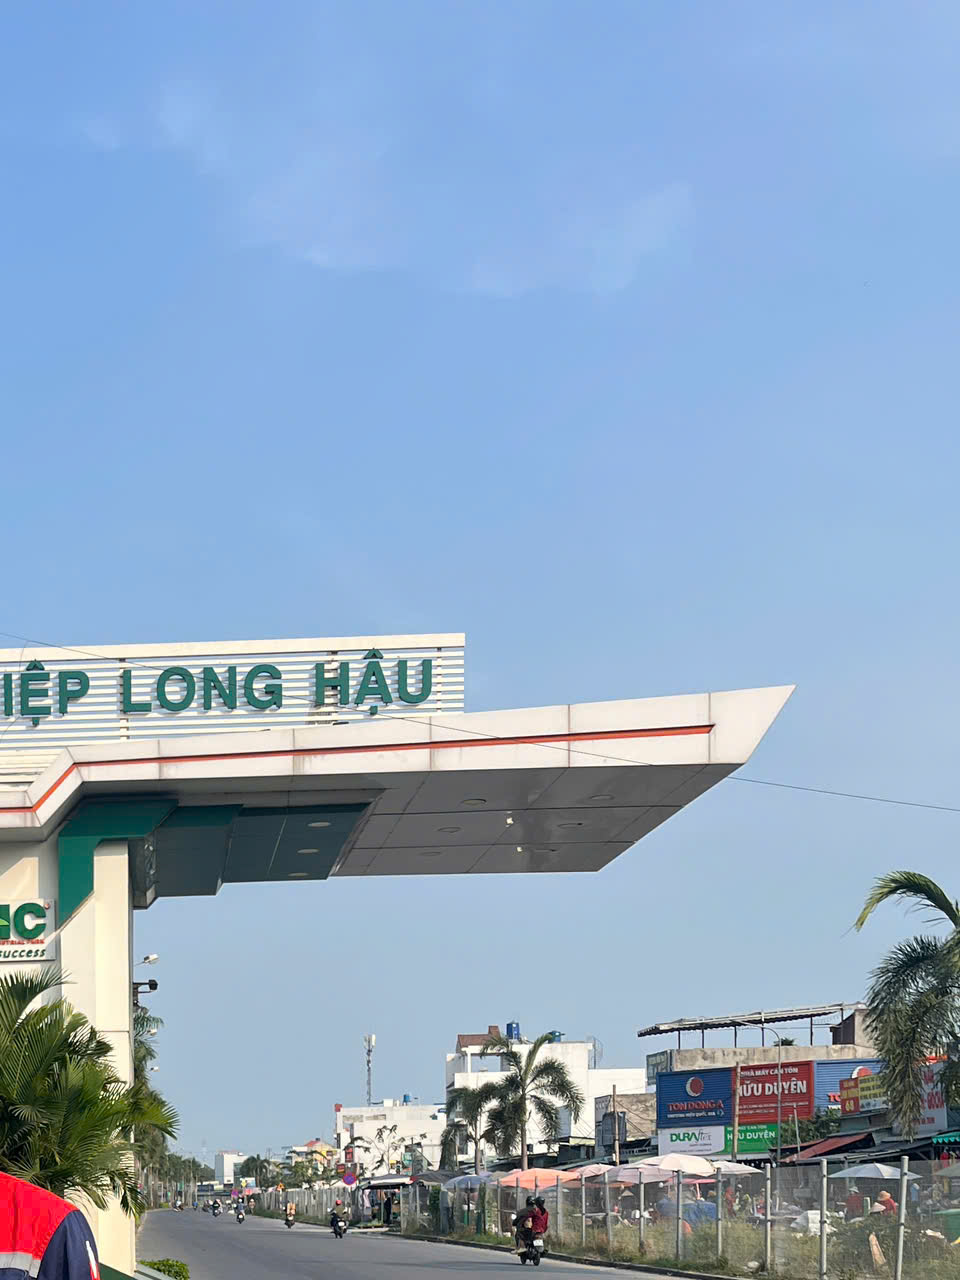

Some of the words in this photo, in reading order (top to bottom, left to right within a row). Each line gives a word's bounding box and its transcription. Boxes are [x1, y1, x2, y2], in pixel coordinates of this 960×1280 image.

[122, 663, 283, 713] LONG
[315, 648, 433, 715] HẬU
[765, 1077, 807, 1095] DUYÊN
[727, 1132, 744, 1140] HU
